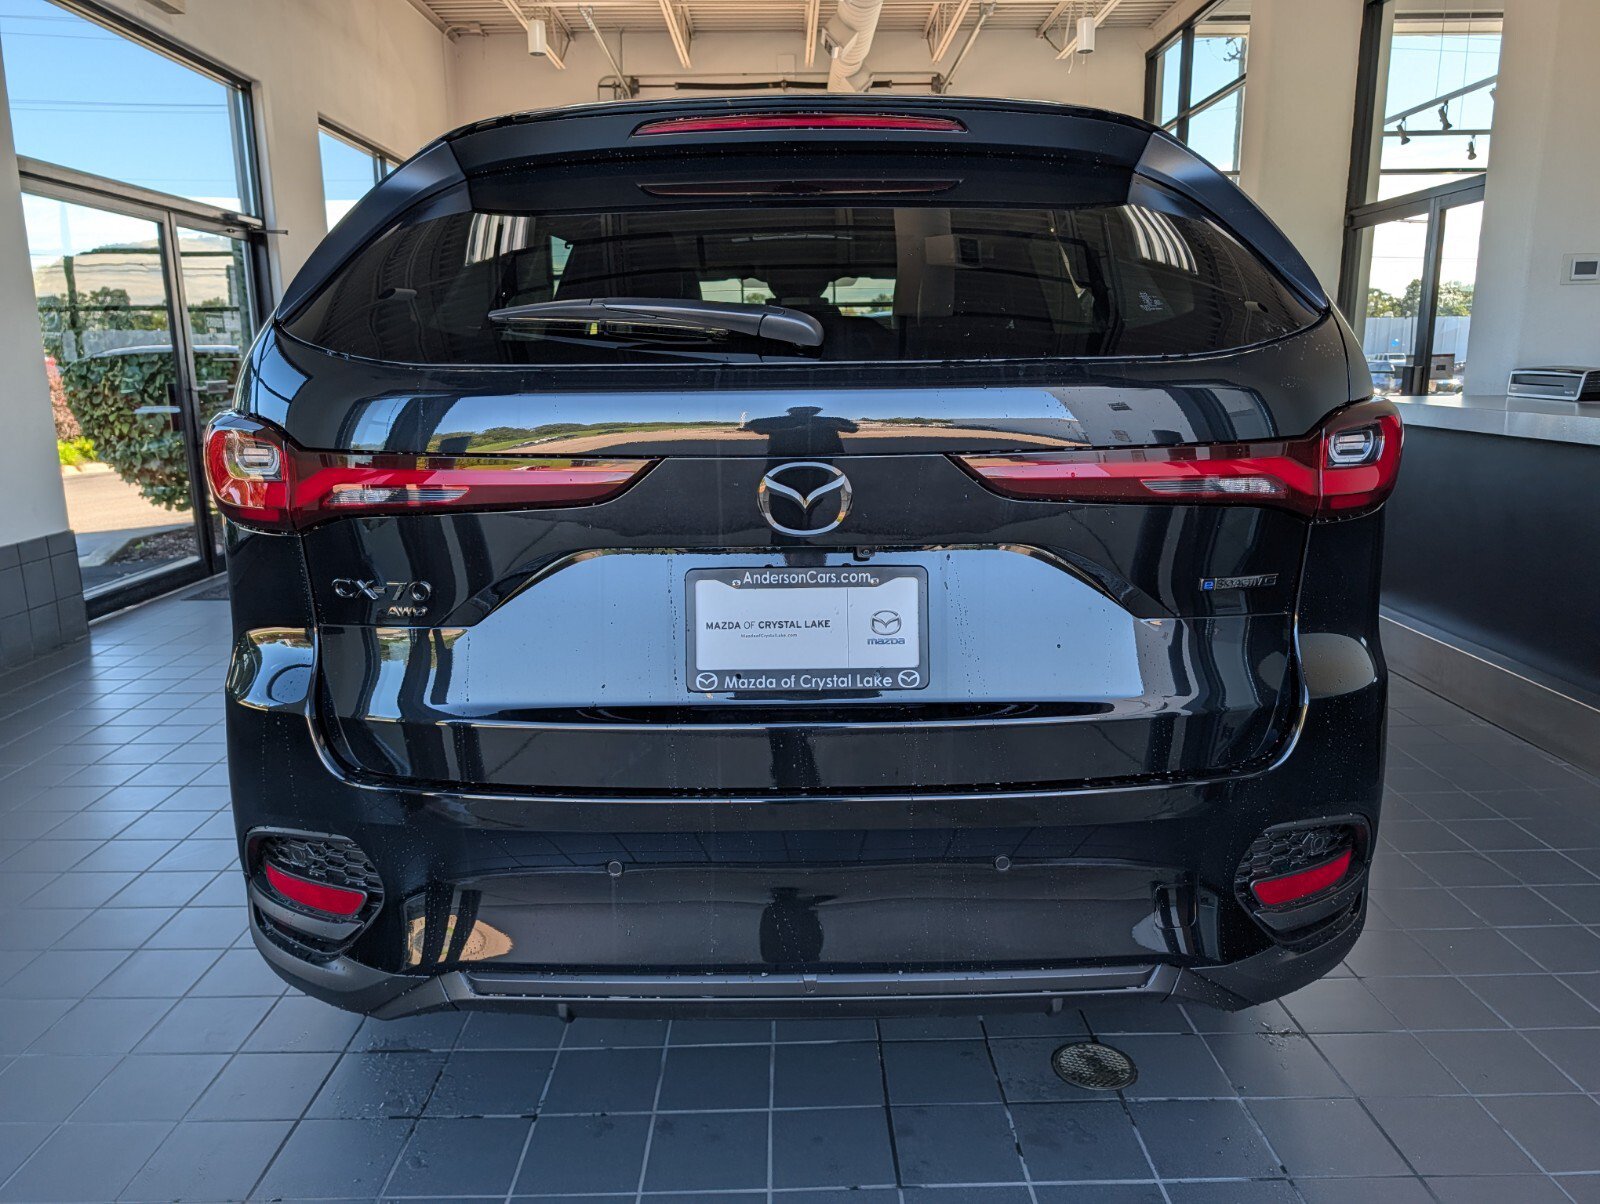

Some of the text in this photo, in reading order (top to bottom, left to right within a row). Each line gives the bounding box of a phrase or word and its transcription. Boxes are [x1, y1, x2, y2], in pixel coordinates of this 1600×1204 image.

[743, 571, 871, 584] AndersonCars.com
[332, 578, 432, 601] CX-70
[387, 605, 428, 616] AWD
[706, 619, 831, 630] MAZDA OF CRYSTAL LAKE
[724, 673, 892, 691] Mazda of Crystal Lake
